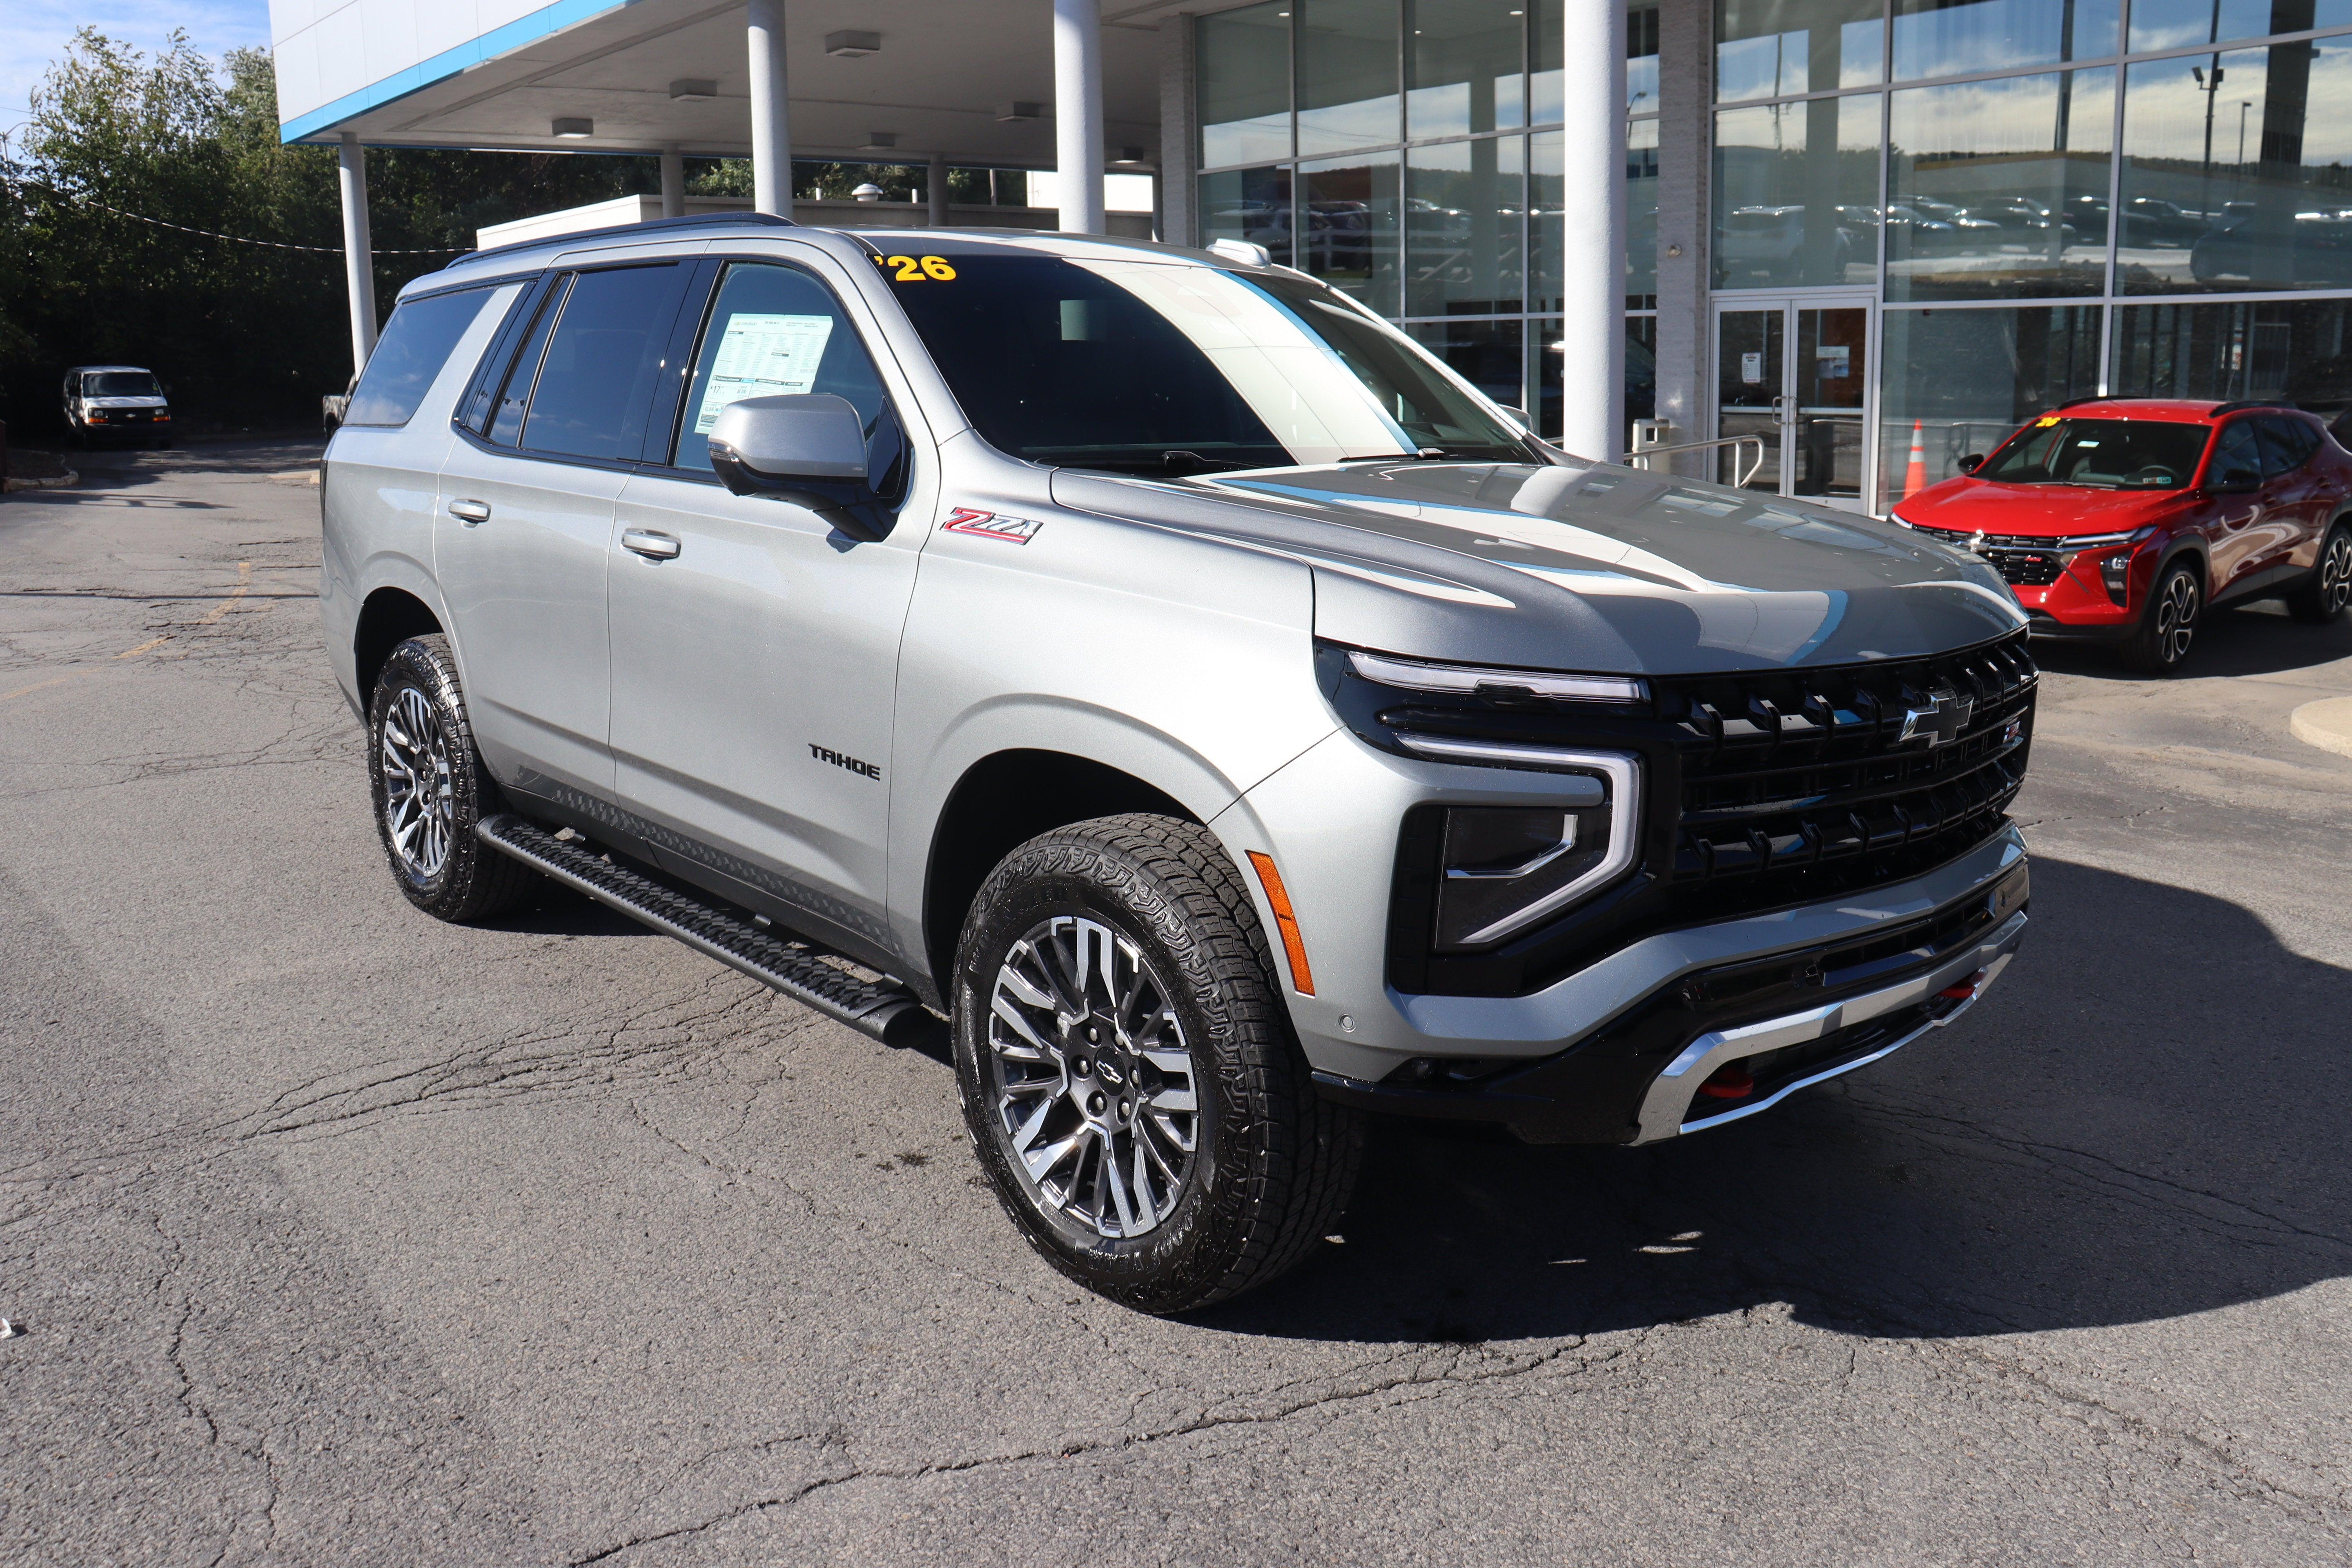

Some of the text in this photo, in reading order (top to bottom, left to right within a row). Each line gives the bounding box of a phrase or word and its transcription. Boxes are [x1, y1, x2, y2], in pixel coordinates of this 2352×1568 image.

[713, 385, 721, 394] 17
[939, 506, 1044, 546] Z71
[808, 742, 880, 782] TAHOE
